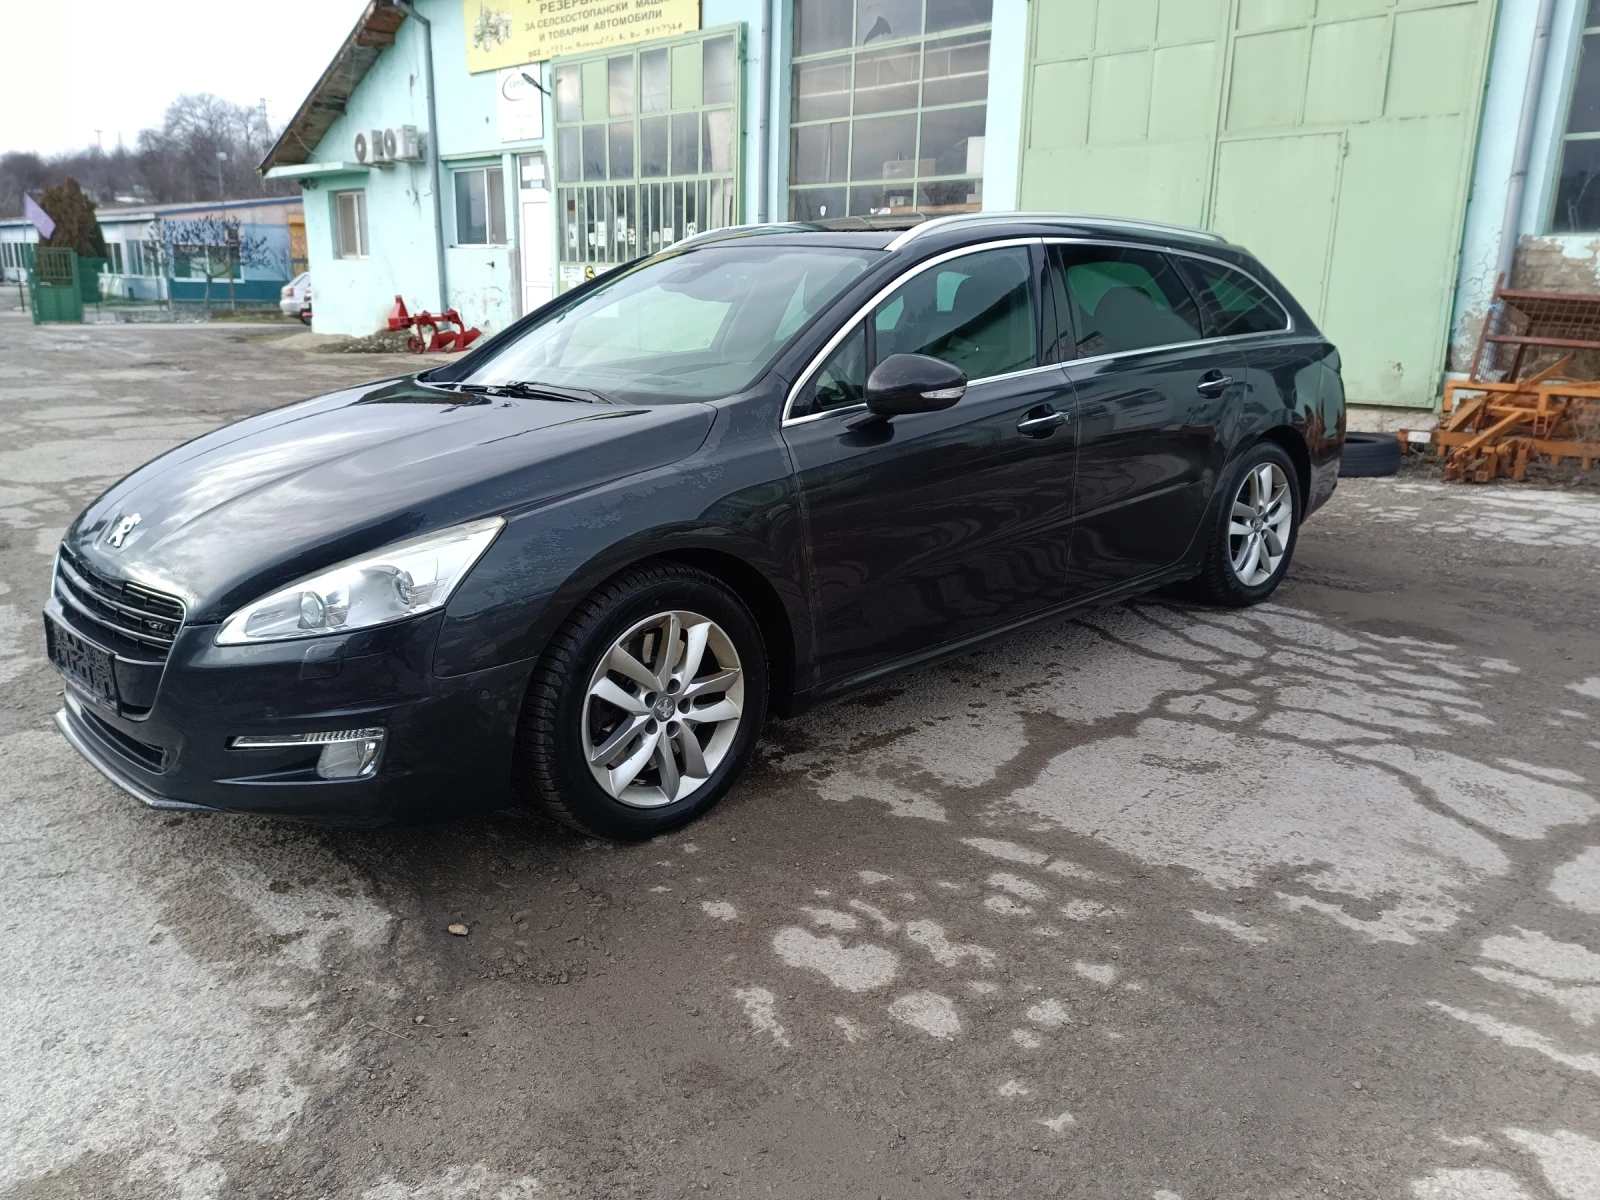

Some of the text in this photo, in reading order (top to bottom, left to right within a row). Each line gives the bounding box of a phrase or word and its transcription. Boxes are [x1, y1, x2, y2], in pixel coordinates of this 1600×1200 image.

[525, 22, 536, 31] ЗА
[537, 2, 629, 29] СЕЛСКОСТОПАНСКИ
[539, 33, 546, 42] И
[548, 24, 589, 40] ТОВАРНИ
[594, 9, 662, 31] АВТОМОБИЛИ
